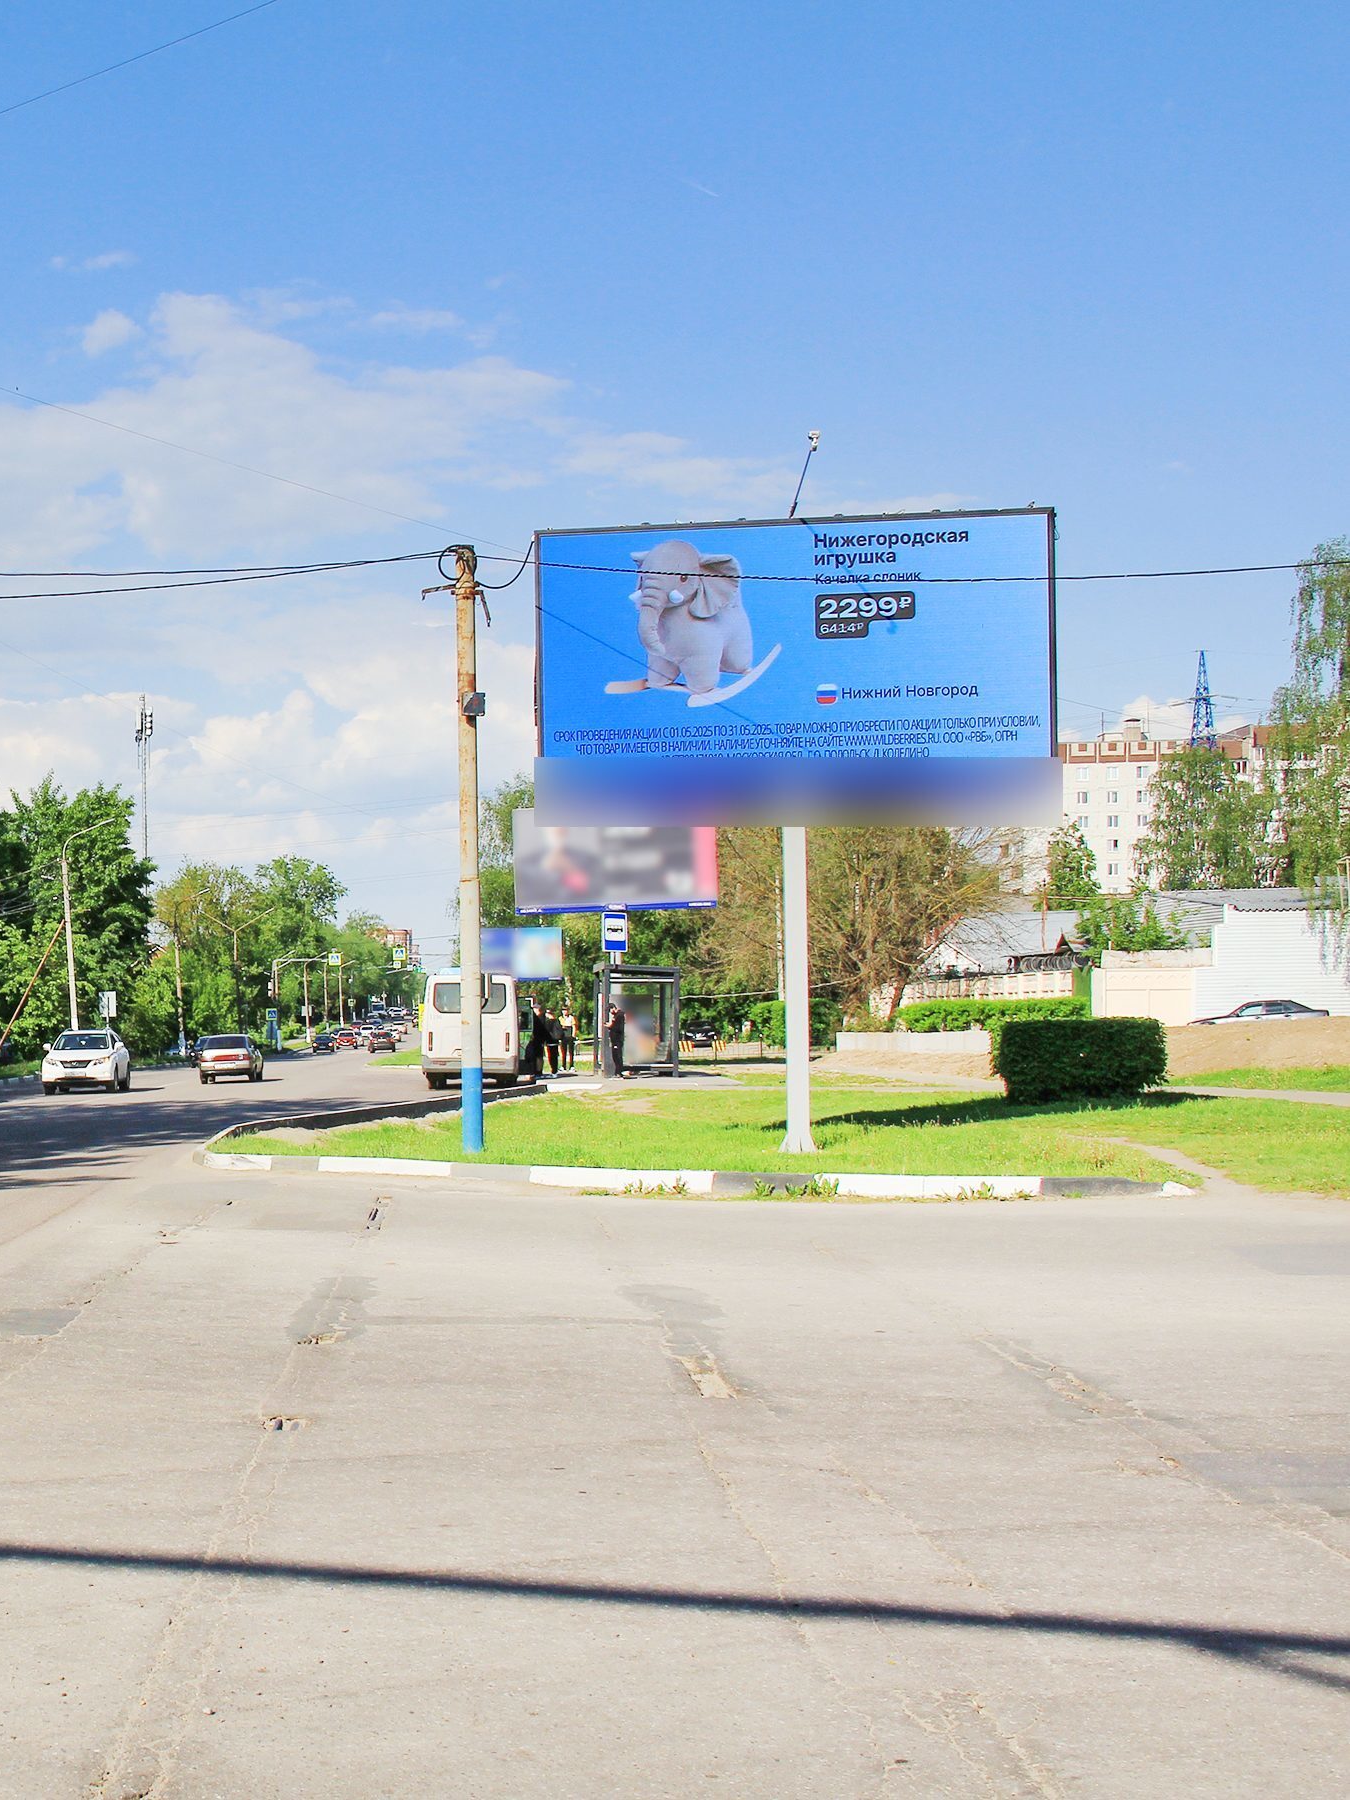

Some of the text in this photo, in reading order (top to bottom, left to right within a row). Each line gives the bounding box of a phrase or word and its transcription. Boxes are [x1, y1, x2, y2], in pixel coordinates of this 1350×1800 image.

[814, 530, 969, 548] Нижегородская
[814, 551, 896, 568] игрушка
[815, 571, 921, 585] Качалка слоник
[841, 685, 979, 699] Нижний Новгород
[553, 730, 575, 742] СРОК
[576, 728, 631, 742] ПРОВЕДЕНИЯ
[633, 727, 662, 741] АКЦИИ
[663, 727, 669, 738] С
[669, 726, 713, 738] 01.05.2025
[714, 725, 727, 736] ПО
[775, 722, 802, 734] ТОВАР
[803, 721, 838, 733] МОЖНО
[840, 719, 895, 732] ПРИОБРЕСТИ
[897, 719, 910, 731] ПО
[911, 718, 941, 732] АКЦИИ
[942, 717, 976, 729] ТОЛЬКО
[978, 716, 996, 728] ПРИ
[997, 715, 1041, 728] УСЛОВИИ,
[575, 743, 592, 755] ЧТО
[593, 743, 620, 755] ТОВАР
[621, 741, 660, 754] ИМЕЕТСЯ
[661, 741, 667, 752] В
[714, 738, 754, 751] НАЛИЧИЕ
[755, 735, 803, 749] УТОЧНЯЙТЕ
[804, 736, 816, 747] НА
[817, 733, 844, 747] САЙТЕ
[943, 731, 963, 743] ООО
[994, 730, 1017, 742] ОГРН
